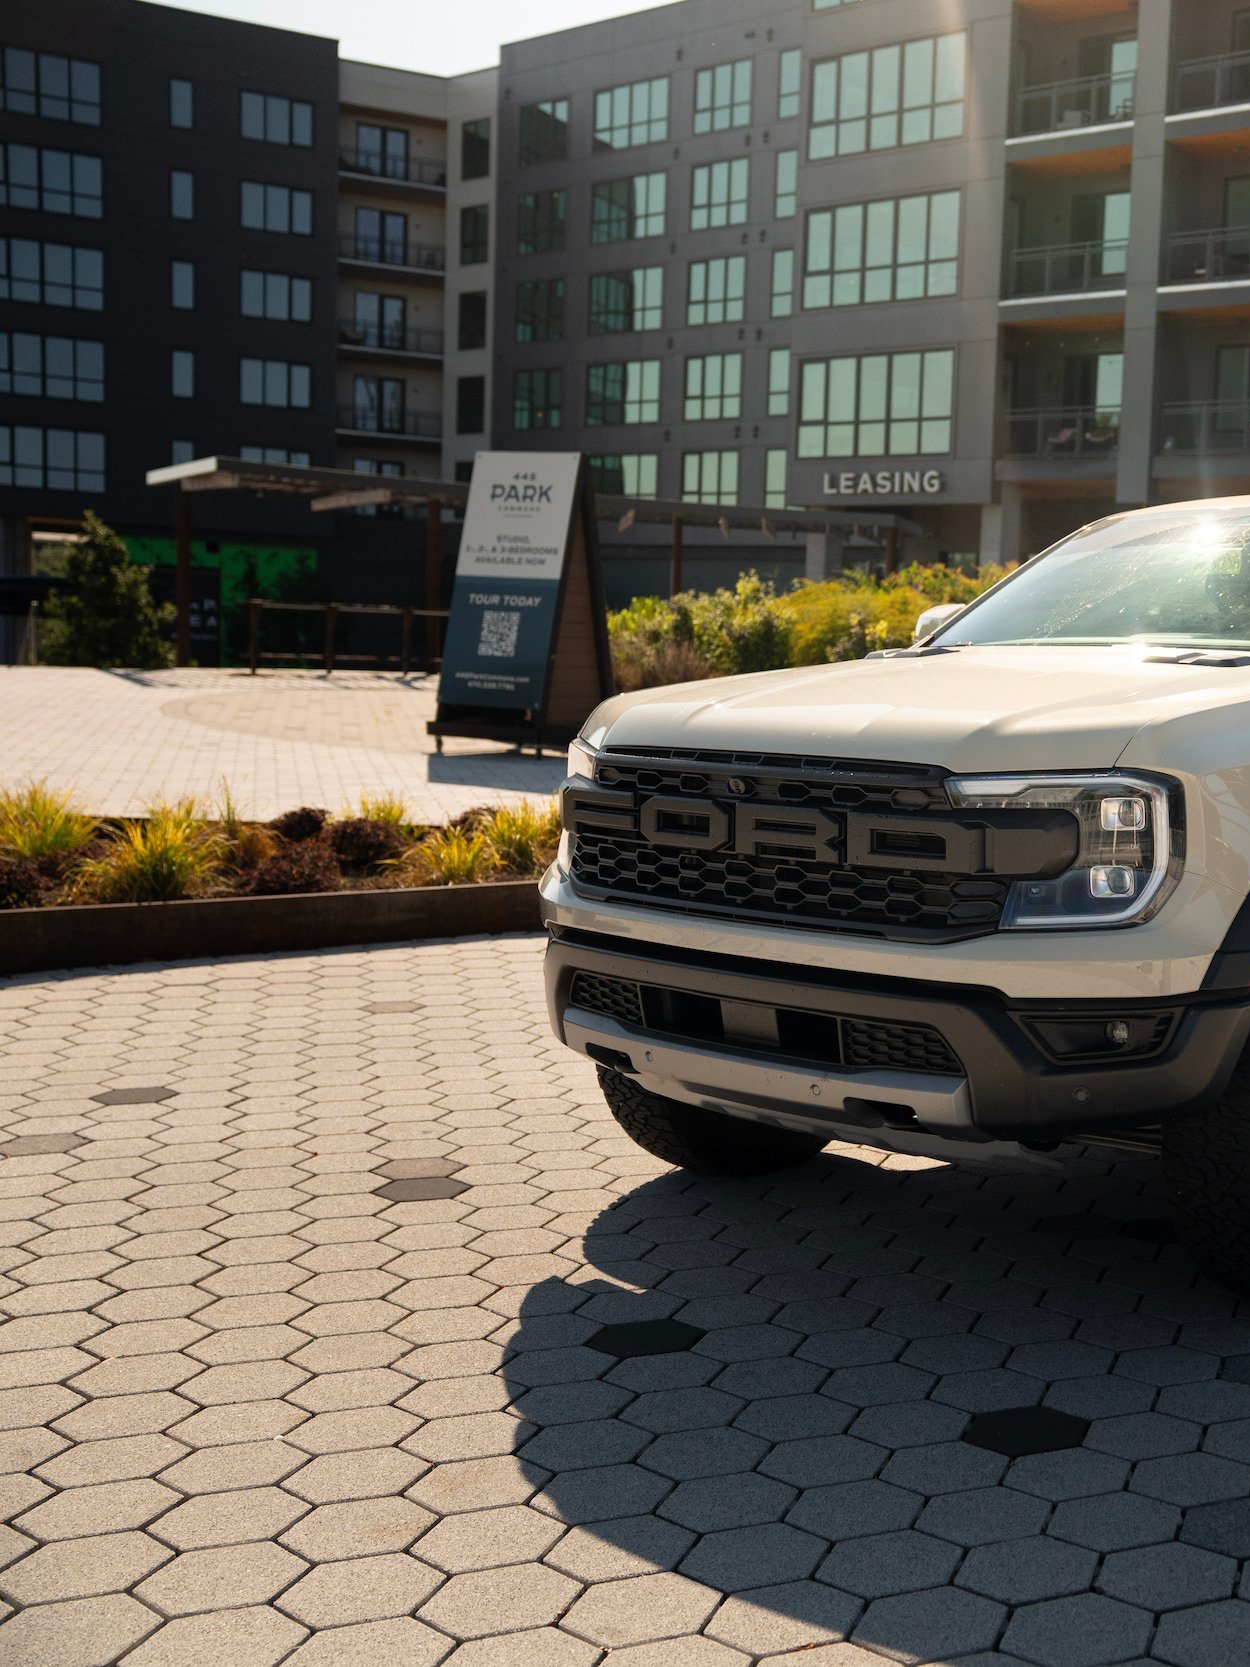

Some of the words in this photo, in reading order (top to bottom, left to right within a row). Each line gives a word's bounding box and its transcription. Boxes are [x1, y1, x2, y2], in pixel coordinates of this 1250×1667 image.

[512, 472, 536, 481] 445
[823, 469, 940, 495] LEASING
[490, 484, 554, 503] PARK
[474, 555, 523, 566] AVAILABLE
[525, 557, 546, 566] NOW
[469, 592, 500, 605] TOUR
[503, 594, 542, 607] TODAY
[561, 776, 987, 873] FORD
